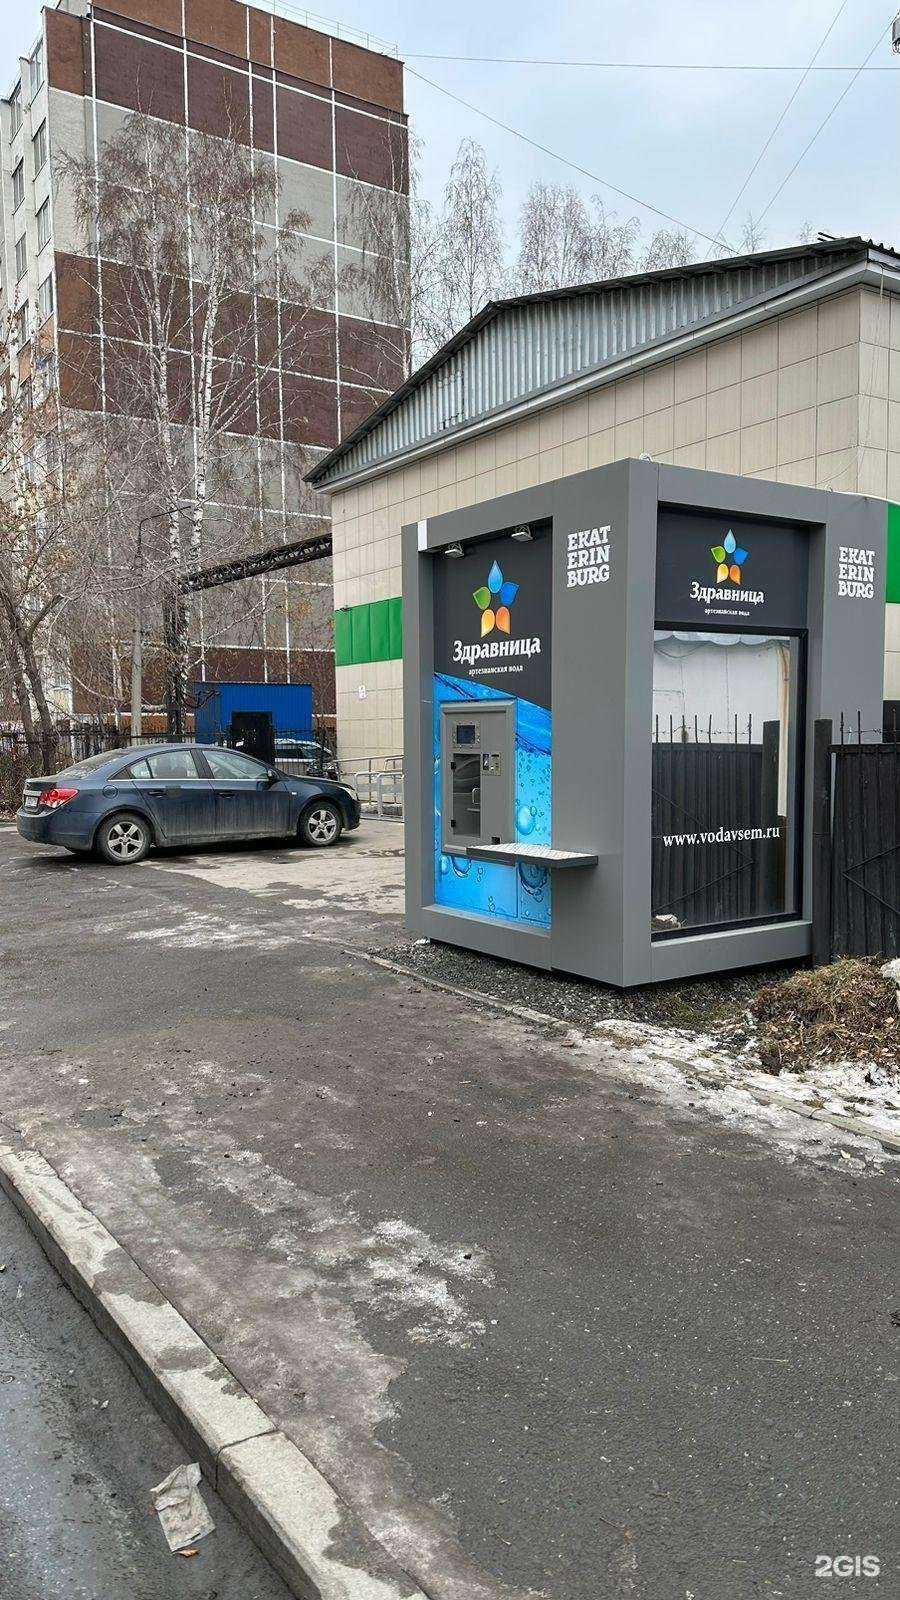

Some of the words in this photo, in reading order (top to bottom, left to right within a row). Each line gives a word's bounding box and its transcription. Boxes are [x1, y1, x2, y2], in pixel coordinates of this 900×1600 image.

[567, 525, 611, 550] EKAT
[567, 545, 611, 569] ERIN
[838, 546, 876, 565] EKAT
[567, 565, 610, 588] BURG
[838, 563, 875, 582] ERIN
[689, 581, 765, 605] Здравница
[838, 580, 875, 599] BURG
[452, 637, 541, 665] Здравница
[468, 666, 508, 676] артезианская
[508, 665, 523, 673] вода
[663, 827, 780, 847] www.vodavsem.ru
